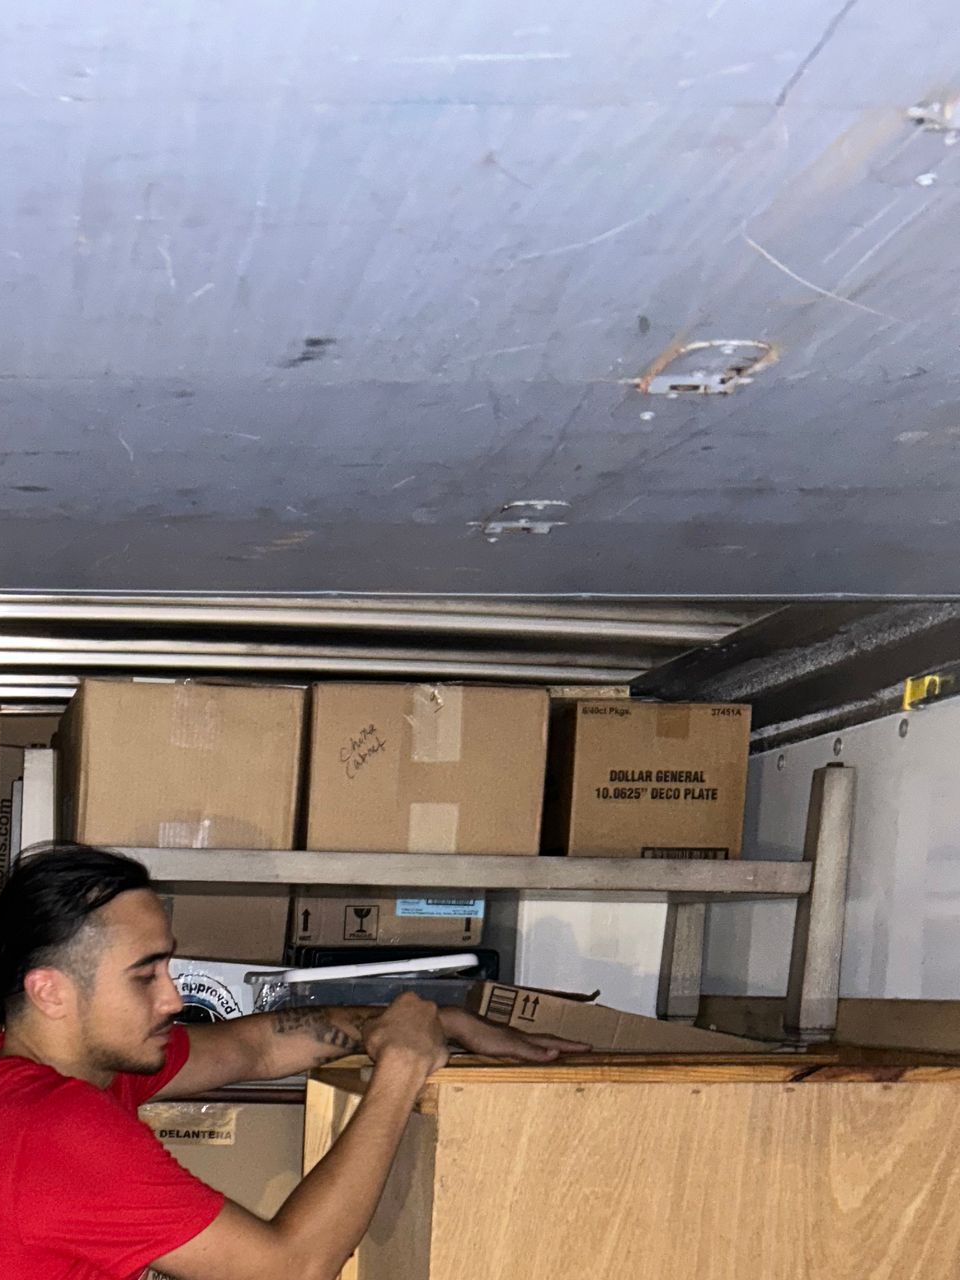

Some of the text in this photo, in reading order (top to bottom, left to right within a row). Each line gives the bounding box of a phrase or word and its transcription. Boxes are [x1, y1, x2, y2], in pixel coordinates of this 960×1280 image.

[609, 769, 706, 783] DOLLAR GENERAL
[651, 788, 680, 800] DECO
[684, 788, 718, 800] PLATE
[181, 981, 237, 1015] approved
[159, 1129, 232, 1139] DELANTERA
